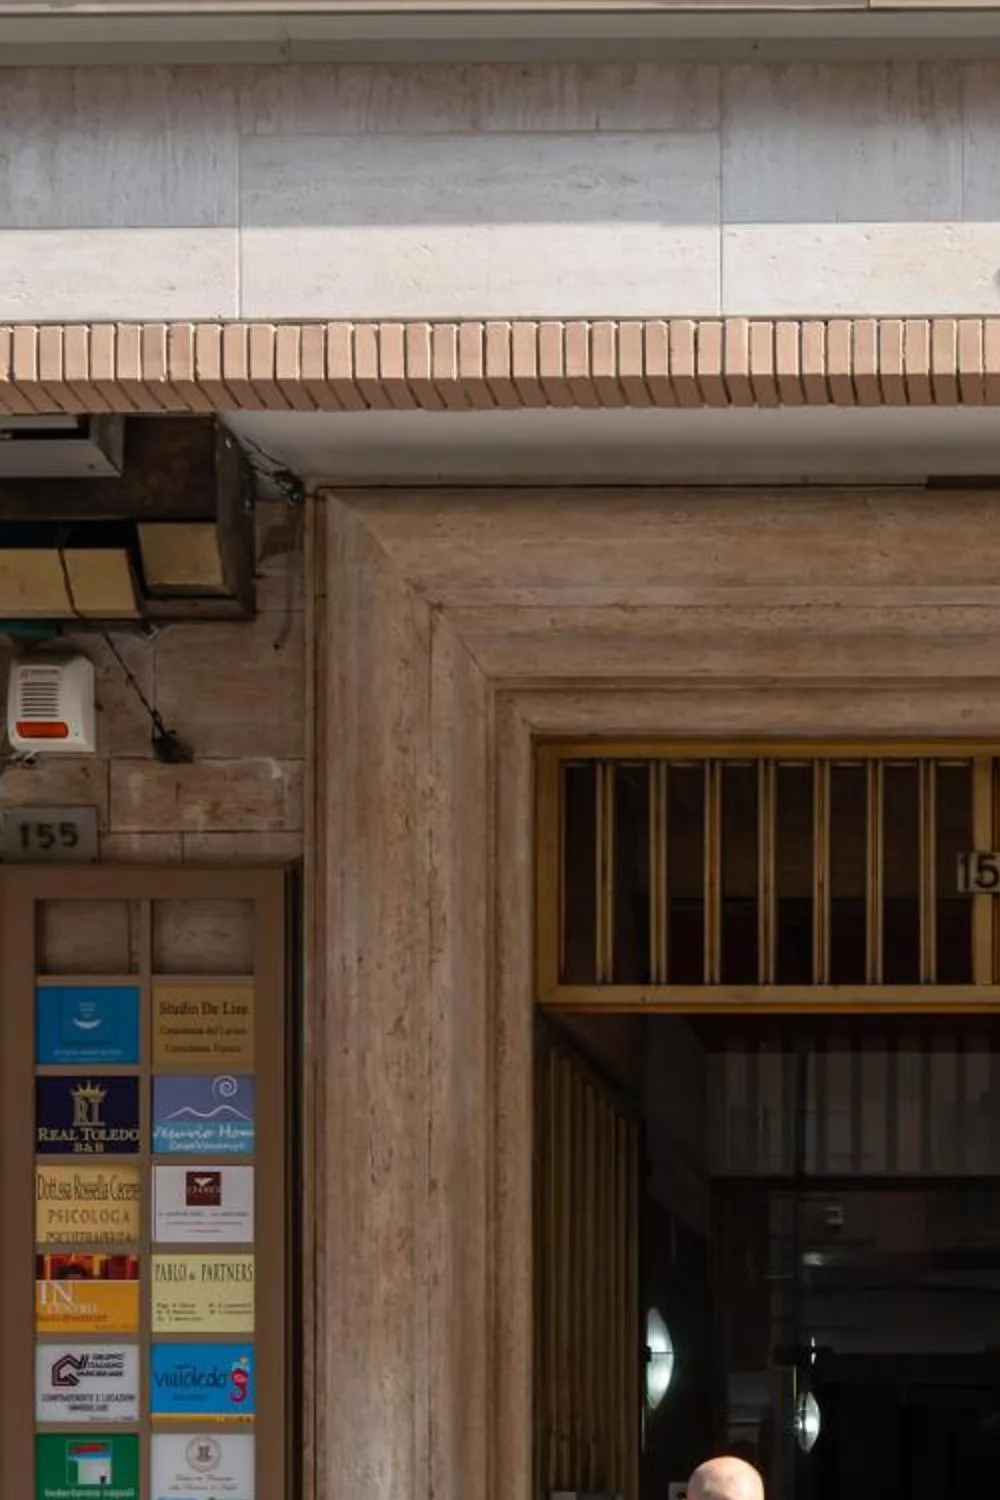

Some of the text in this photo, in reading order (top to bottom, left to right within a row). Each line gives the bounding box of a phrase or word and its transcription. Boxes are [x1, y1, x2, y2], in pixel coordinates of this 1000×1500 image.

[19, 821, 80, 851] 155
[38, 1126, 140, 1142] REAL TOLEDO
[47, 1209, 130, 1225] PSICOLOGA
[201, 1263, 253, 1282] PARTNERS
